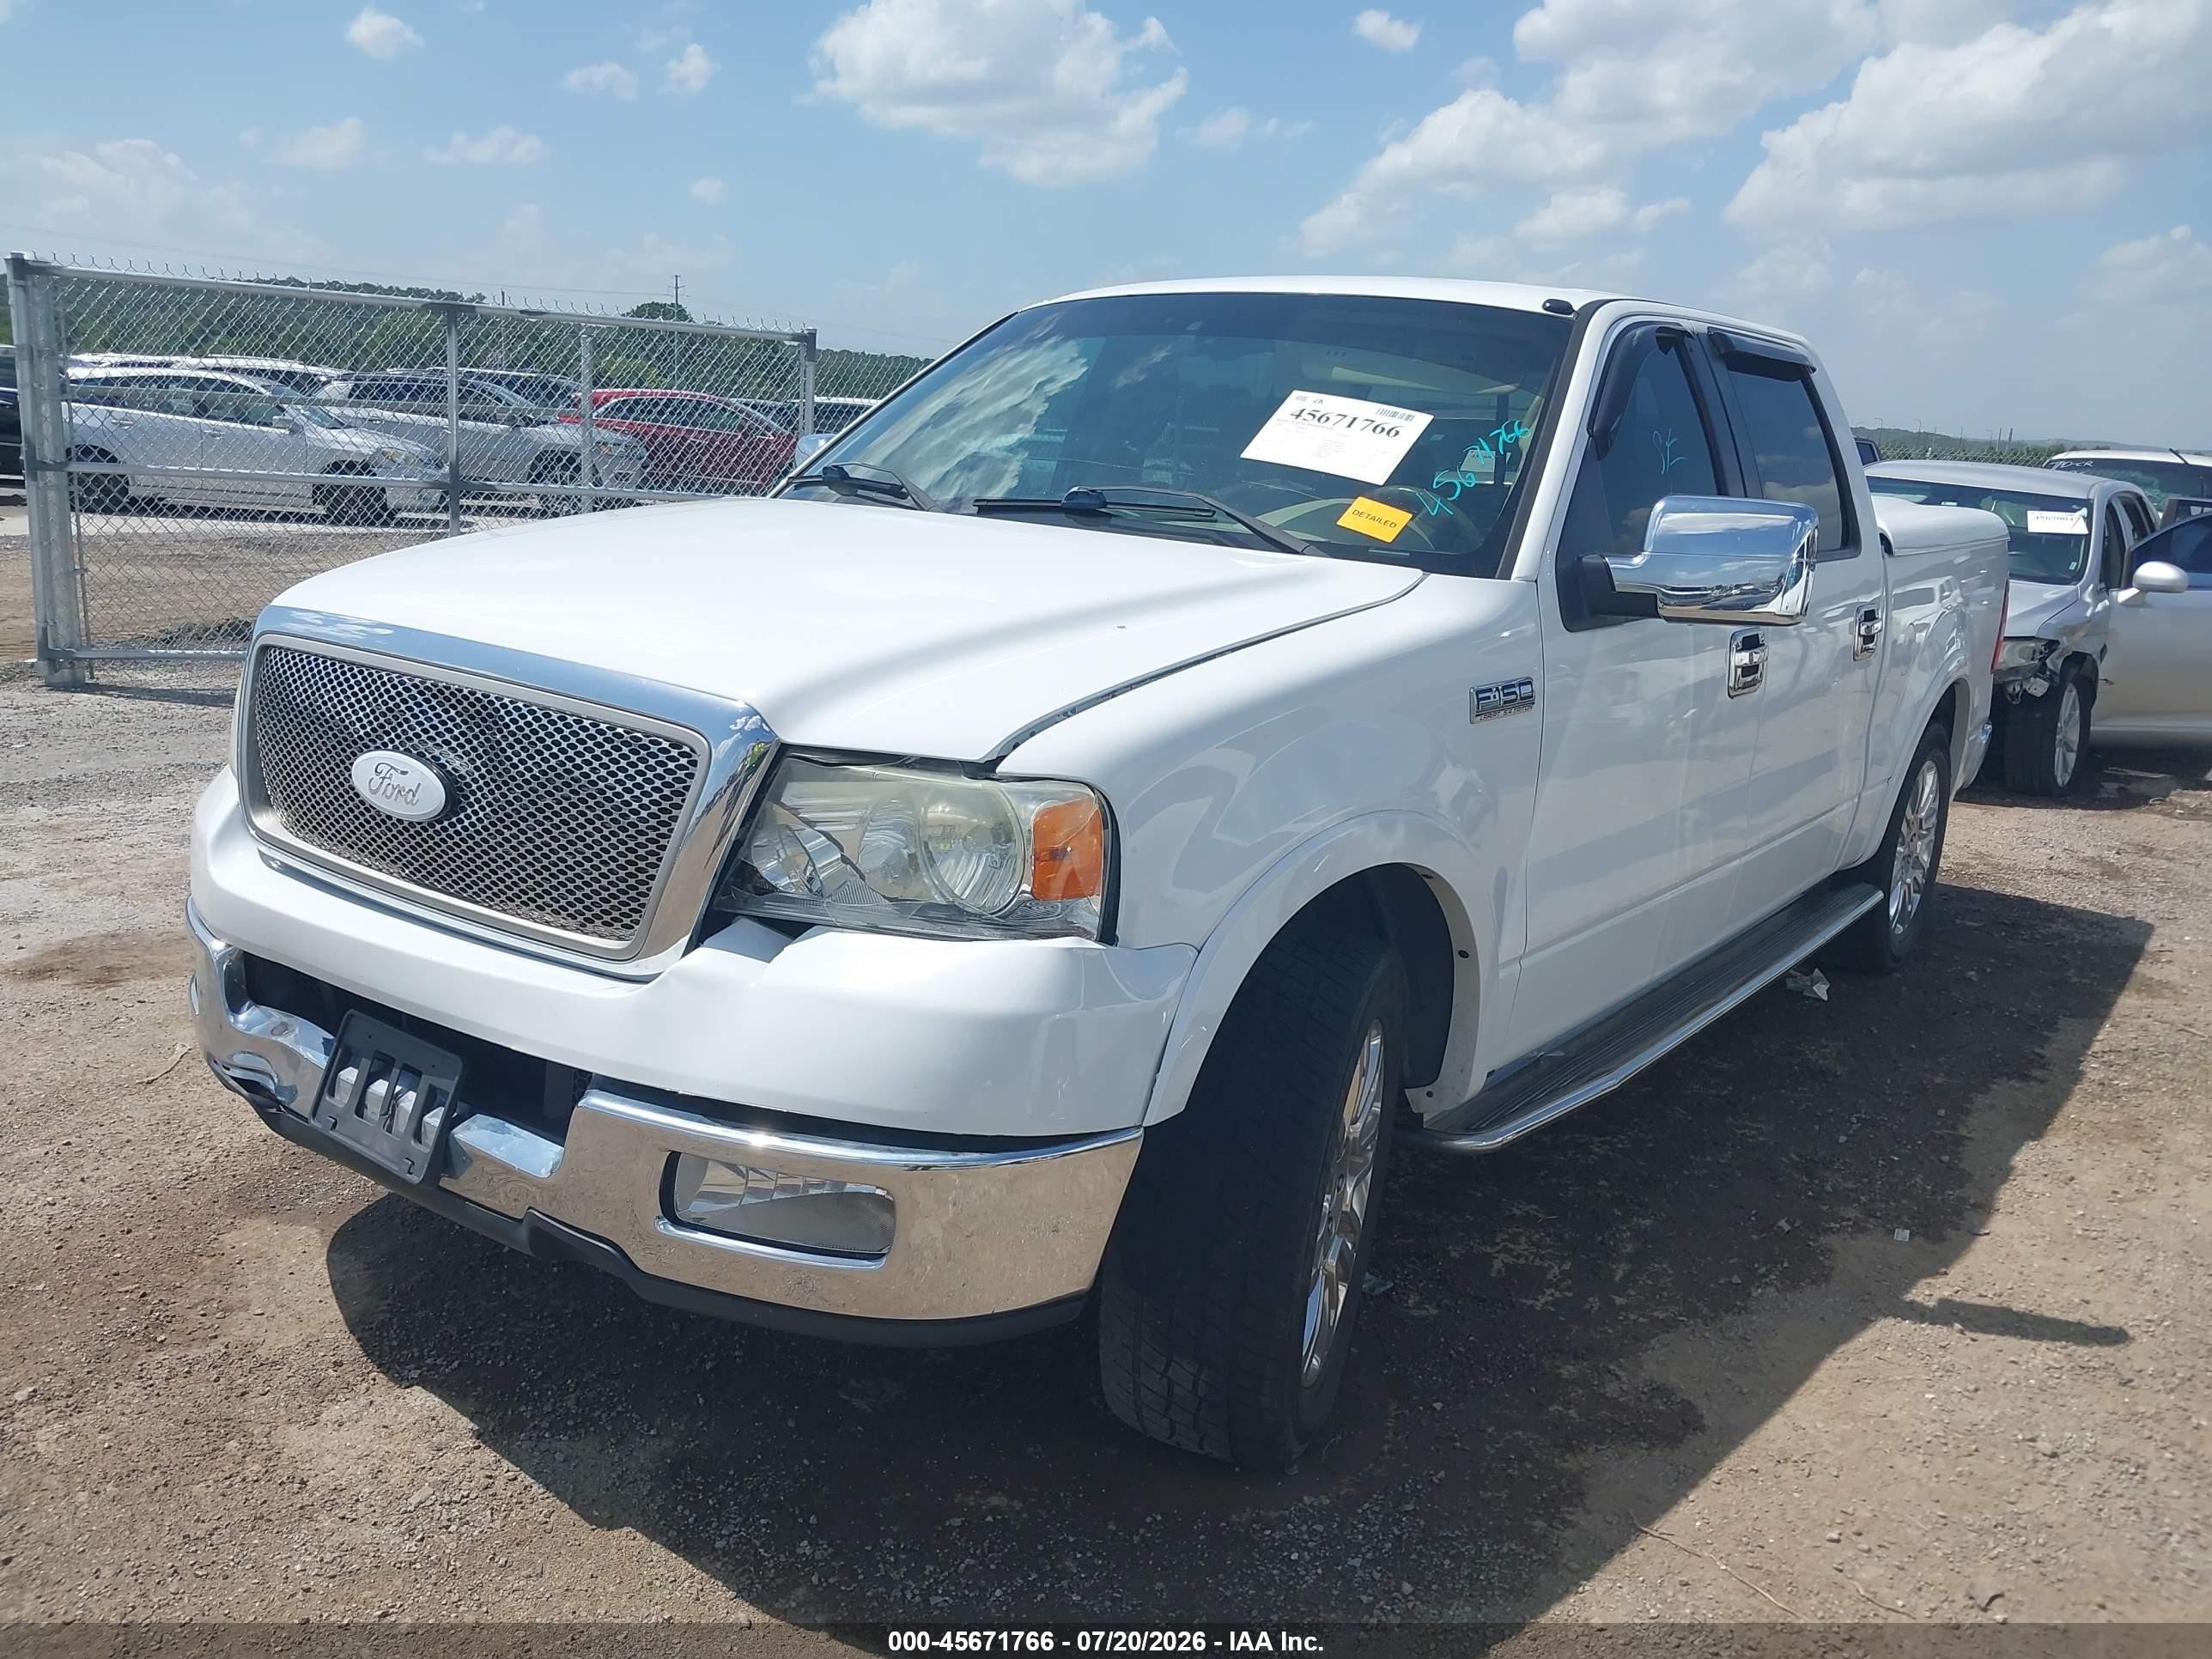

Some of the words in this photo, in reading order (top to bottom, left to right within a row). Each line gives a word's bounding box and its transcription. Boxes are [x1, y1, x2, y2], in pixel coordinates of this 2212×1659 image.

[1290, 408, 1402, 438] 45671766
[1351, 507, 1397, 530] DETAILED
[368, 762, 421, 806] Ford
